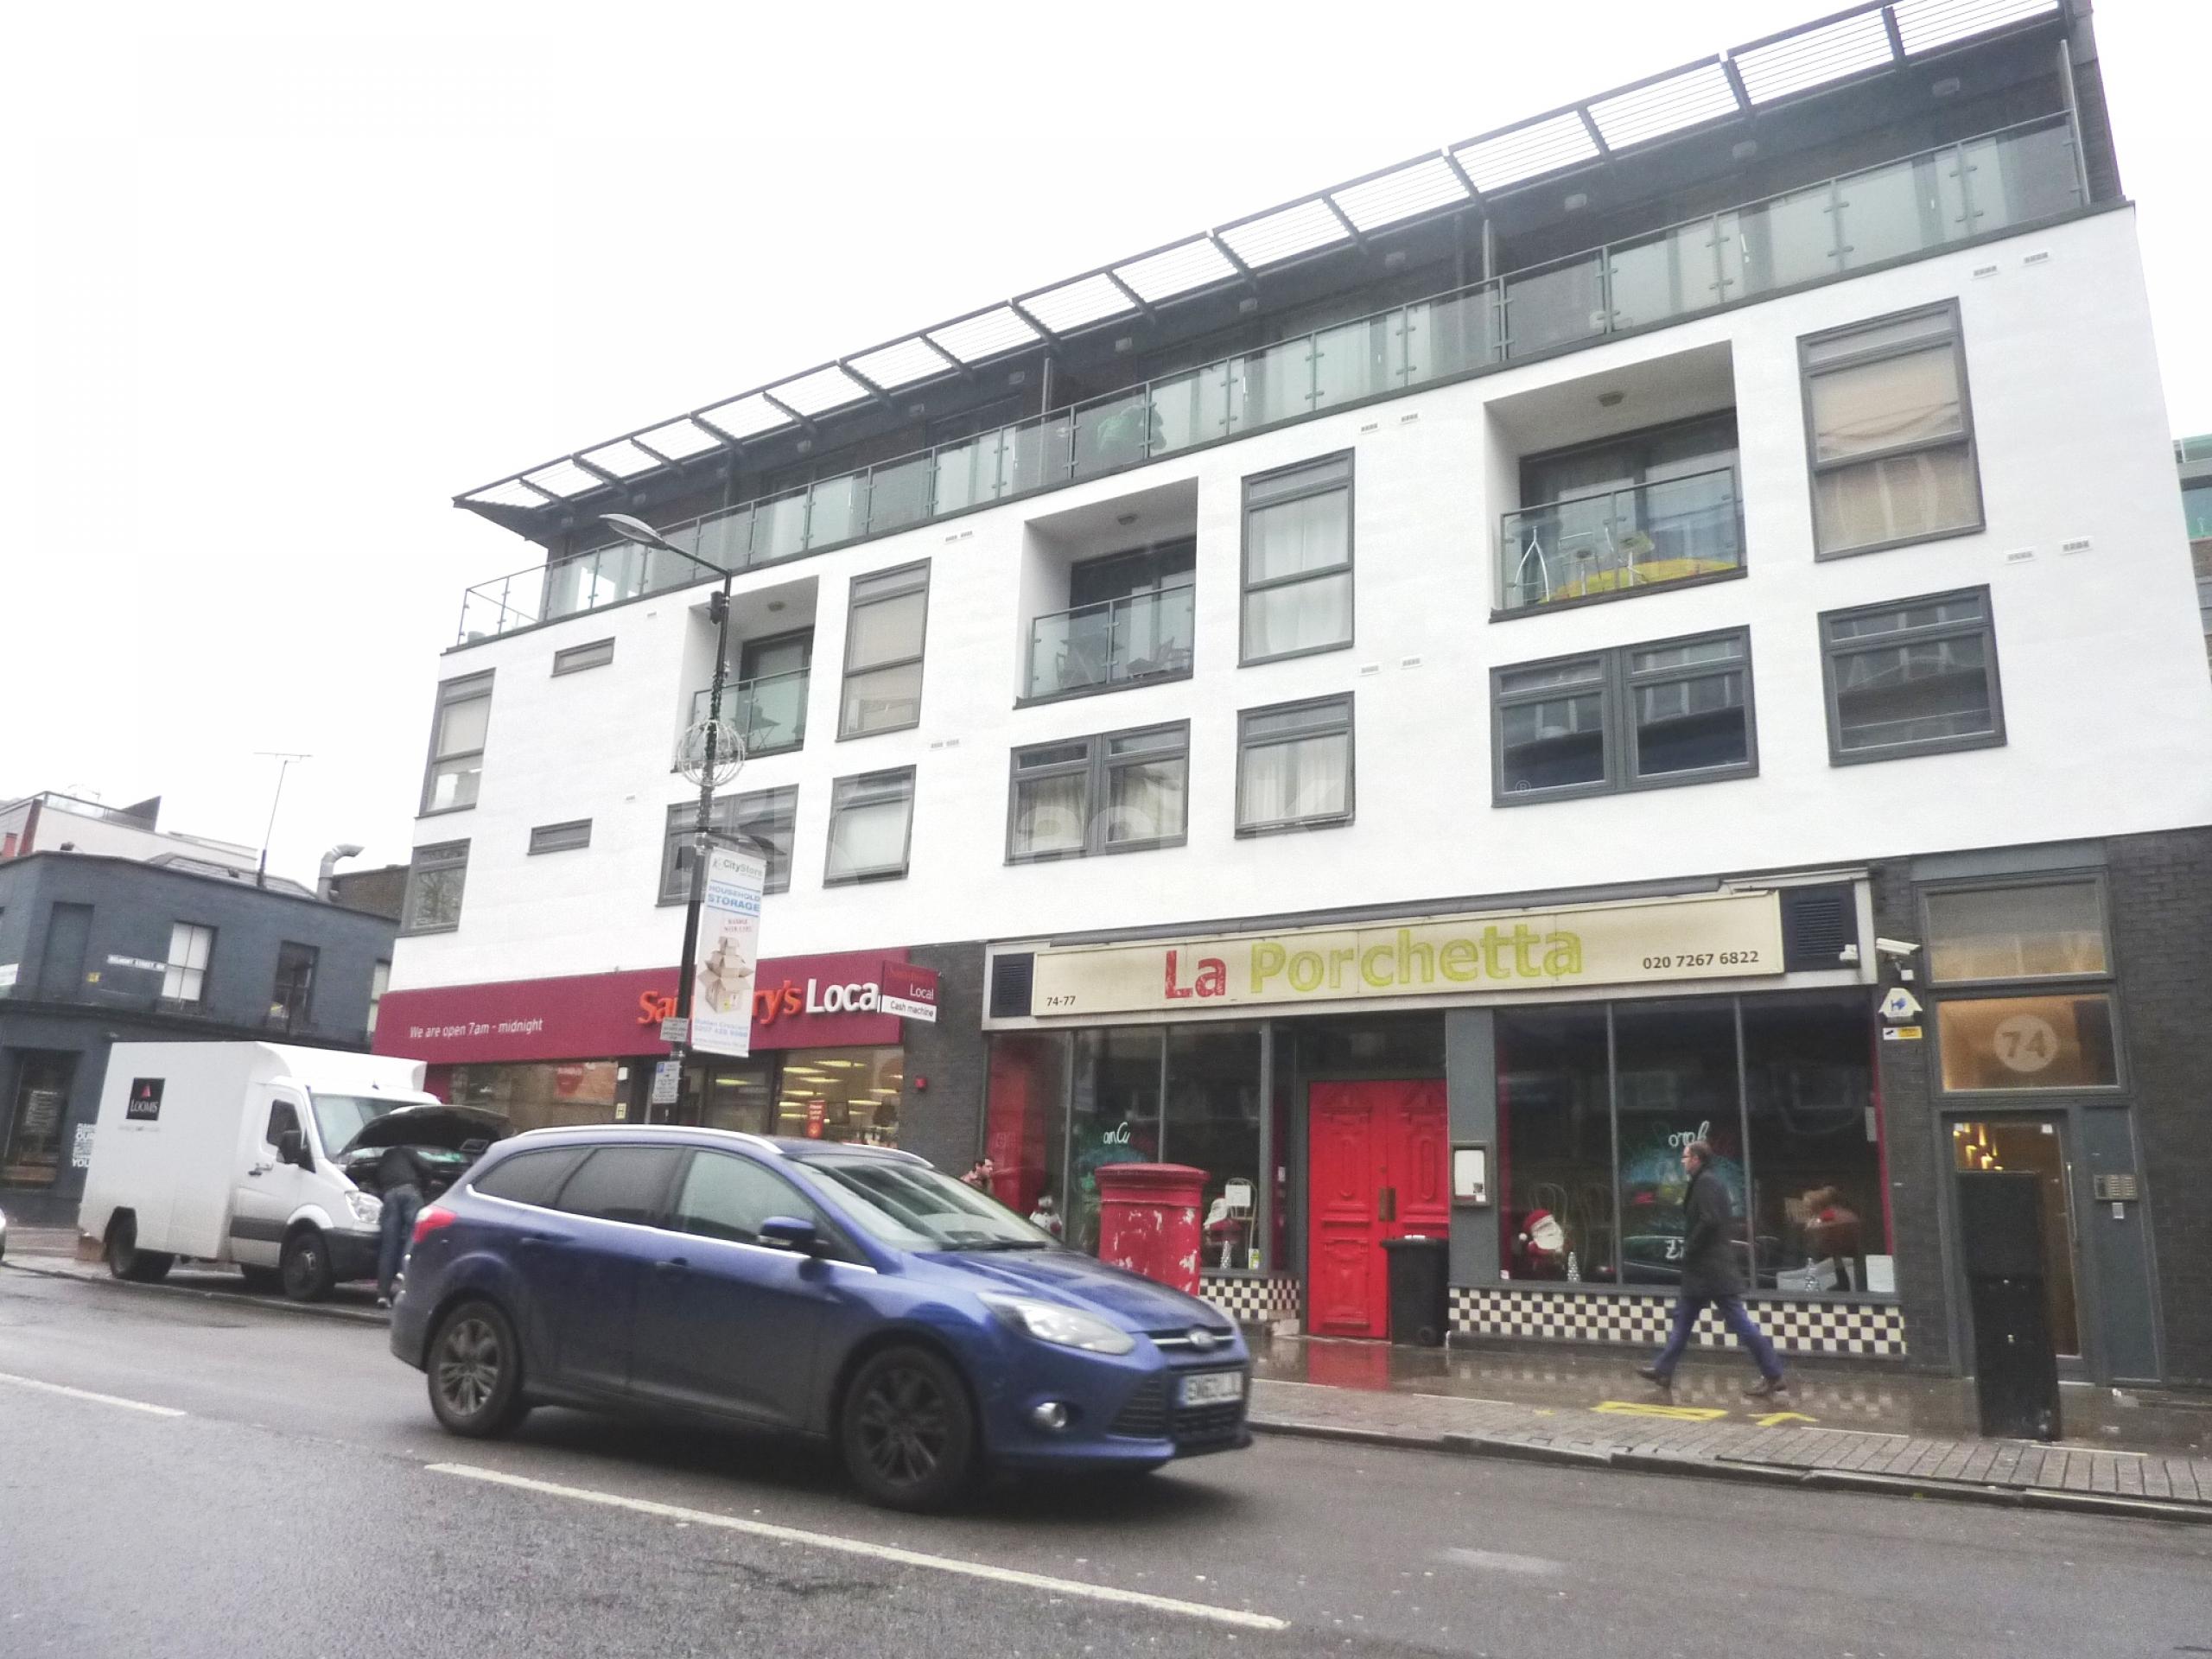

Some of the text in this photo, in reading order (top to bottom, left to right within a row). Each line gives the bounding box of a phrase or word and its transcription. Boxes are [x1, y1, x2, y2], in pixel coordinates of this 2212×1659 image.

[723, 859, 763, 877] CityStore
[709, 885, 761, 901] HOUSEHOLD
[708, 893, 760, 912] STORAGE
[1165, 924, 1583, 999] La Porchetta
[1643, 950, 1759, 969] 020 7267 6822
[910, 983, 934, 1000] Local
[890, 1001, 934, 1017] Cash machine
[1046, 995, 1076, 1007] 74-77
[410, 1026, 423, 1038] We
[424, 1027, 442, 1037] are
[442, 1025, 466, 1039] open
[468, 1022, 489, 1035] 7am
[498, 1018, 543, 1034] midnight
[2001, 1029, 2045, 1058] 74
[130, 1099, 159, 1114] LOOMIS
